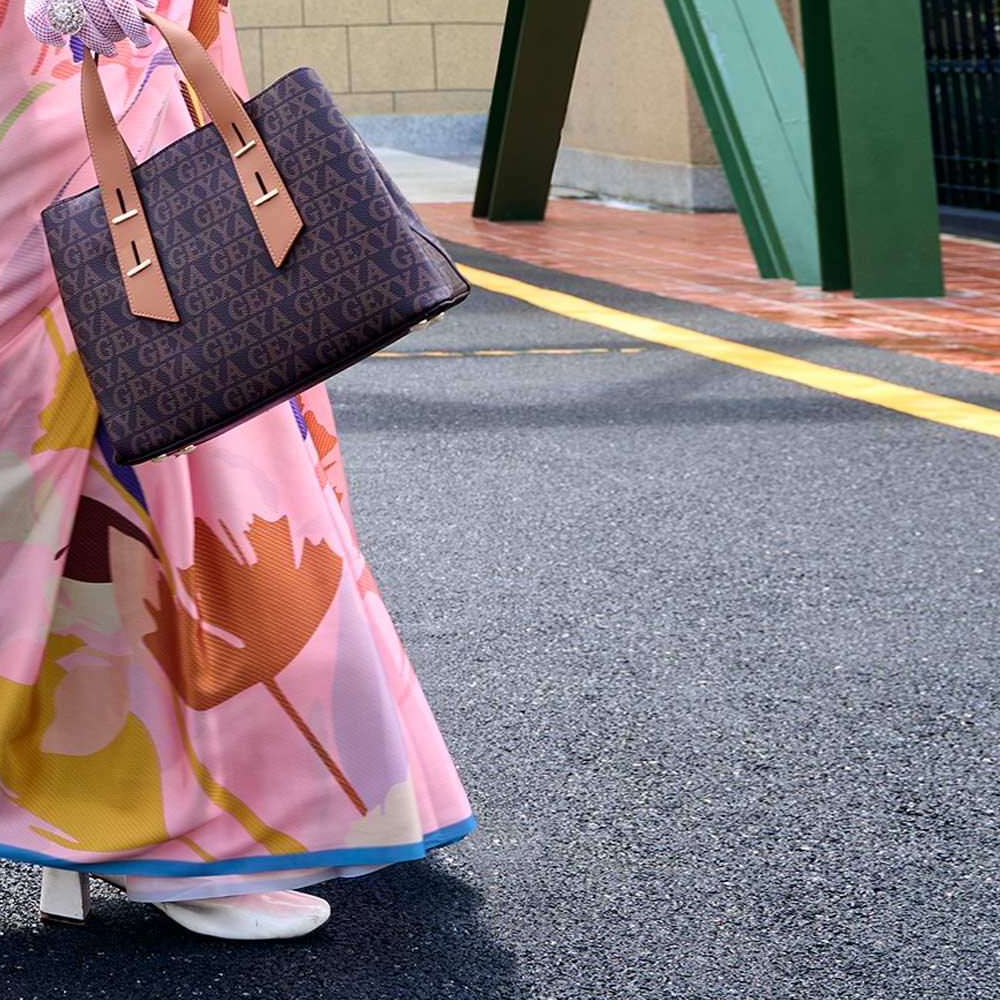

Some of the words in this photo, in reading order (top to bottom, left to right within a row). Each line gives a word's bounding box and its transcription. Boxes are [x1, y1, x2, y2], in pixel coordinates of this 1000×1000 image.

[251, 78, 307, 120] XYA
[178, 145, 231, 183] GEX
[64, 229, 113, 269] GEX
[266, 112, 322, 158] XYA
[288, 166, 347, 206] XYA
[193, 188, 246, 229] GEX
[210, 233, 266, 273] GEX
